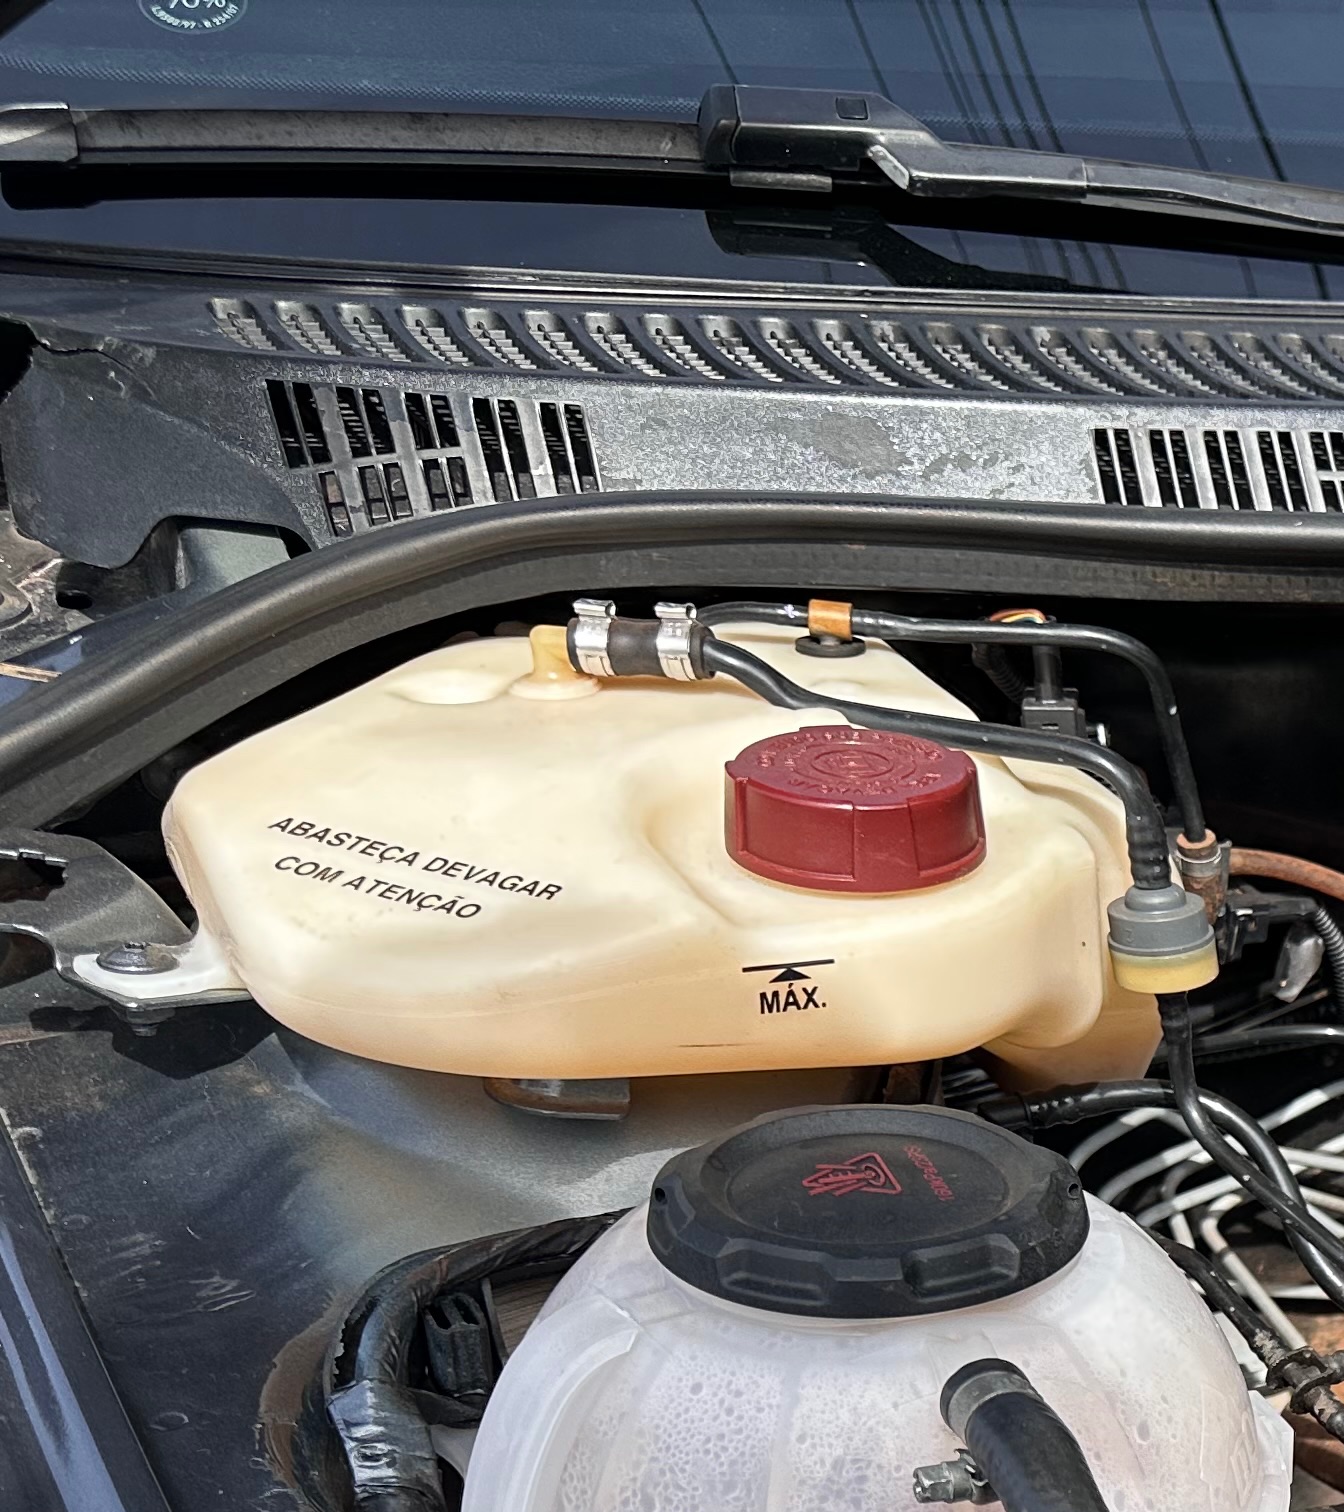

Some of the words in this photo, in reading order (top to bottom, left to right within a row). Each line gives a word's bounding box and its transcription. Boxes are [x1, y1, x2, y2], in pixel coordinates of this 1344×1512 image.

[268, 815, 419, 868] ABASTEÇA
[425, 855, 563, 902] DEVAGAR
[274, 853, 344, 887] COM
[345, 873, 483, 921] ATENÇÃO
[759, 982, 828, 1015] MÁX.
